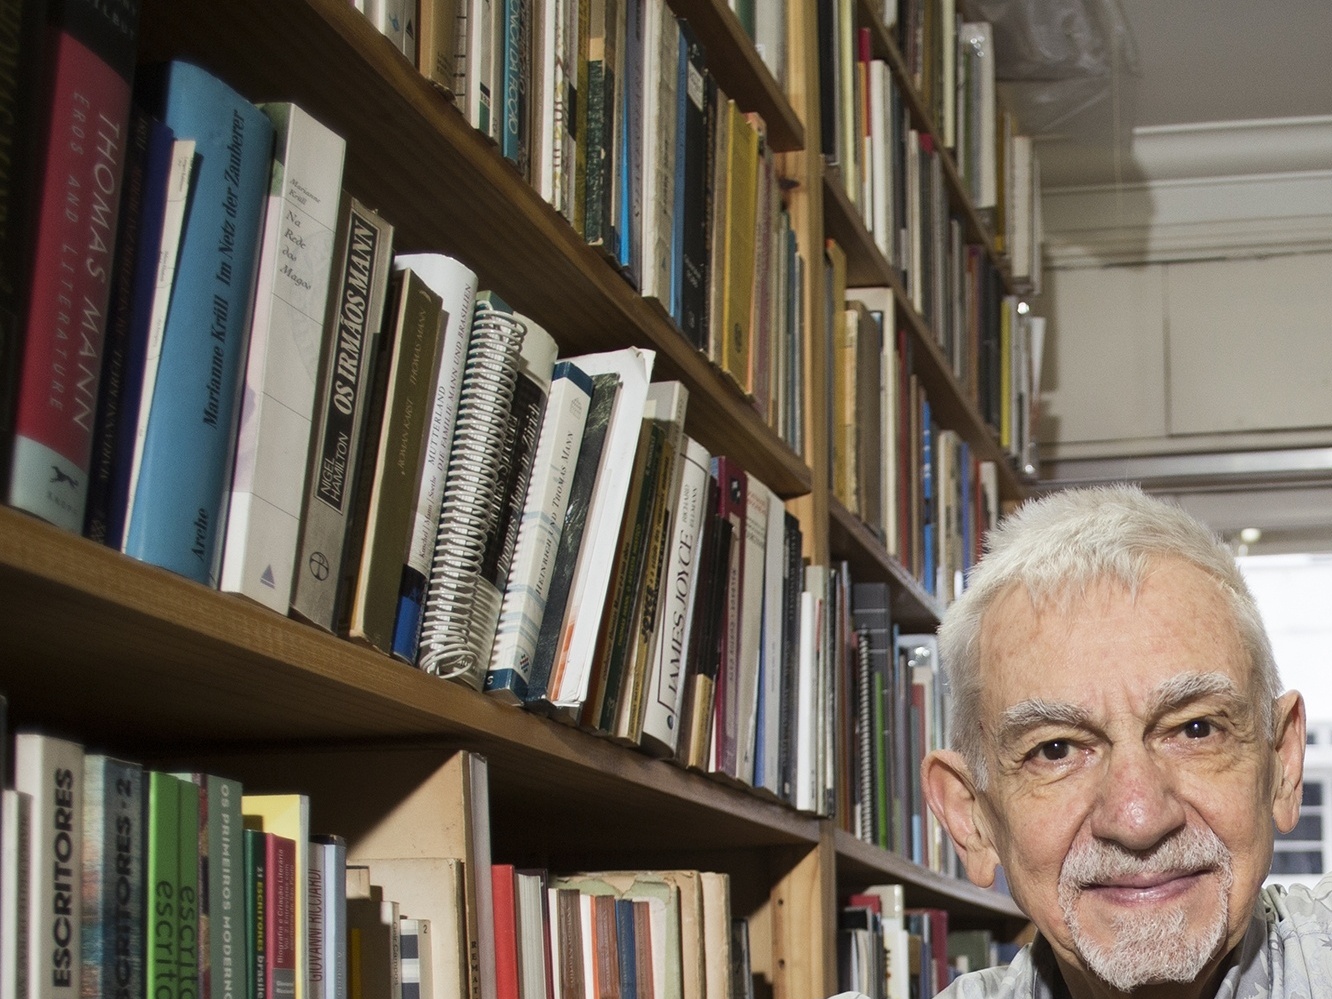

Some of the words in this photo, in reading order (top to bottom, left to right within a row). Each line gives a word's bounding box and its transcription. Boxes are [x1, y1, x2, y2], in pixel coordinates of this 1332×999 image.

[69, 92, 91, 153] EROS
[224, 109, 246, 188] Zauberer
[63, 175, 83, 223] AND
[84, 112, 120, 283] THOMAS
[221, 190, 238, 217] der
[286, 210, 301, 228] Na
[217, 220, 235, 259] Netz
[345, 220, 376, 295] MANN
[214, 264, 231, 286] Im
[48, 243, 77, 410] LITERATURE
[209, 294, 228, 343] Krüll
[457, 282, 472, 337] BRASILIEN
[70, 295, 103, 432] MANN
[335, 294, 367, 383] IRMÃOS
[452, 339, 463, 364] UND
[201, 345, 223, 430] Marianne
[331, 383, 356, 416] OS
[447, 367, 458, 399] MANN
[426, 384, 446, 464] MUTTERLAND
[439, 404, 452, 447] FAMILIE
[519, 402, 540, 452] Zürich
[318, 458, 337, 495] NIGEL
[328, 432, 350, 502] HAMILTON
[435, 453, 445, 470] DIE
[516, 452, 530, 469] in
[507, 472, 526, 513] Mann
[190, 507, 211, 561] Arche
[494, 515, 517, 574] Thomas
[673, 530, 693, 610] JOYCE
[665, 611, 684, 693] JAMES
[219, 783, 230, 808] OS
[51, 768, 74, 988] ESCRITORES
[220, 813, 232, 909] PRIMEIROS
[255, 865, 265, 878] 21
[255, 881, 265, 951] ESCRITORES
[309, 867, 322, 923] RICCIARDI
[309, 926, 322, 982] GIOVANNI
